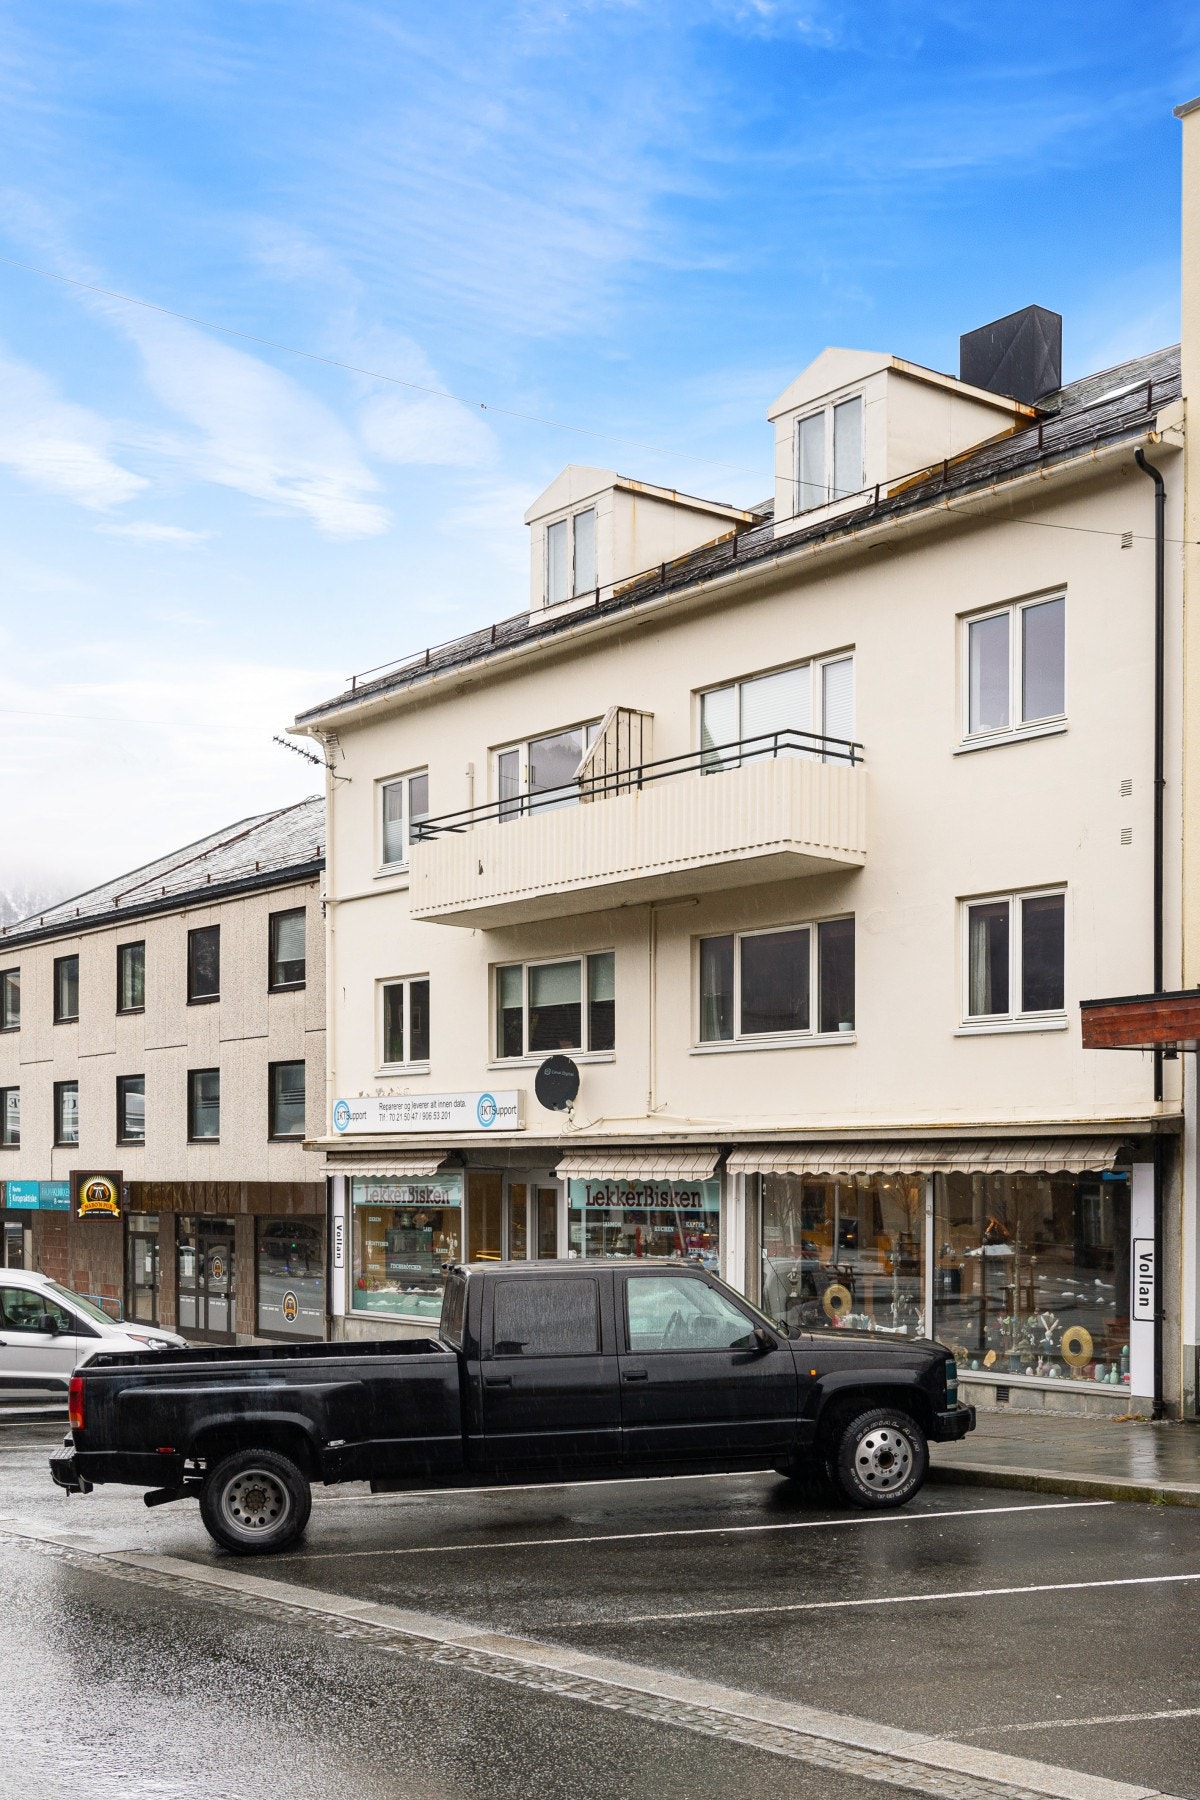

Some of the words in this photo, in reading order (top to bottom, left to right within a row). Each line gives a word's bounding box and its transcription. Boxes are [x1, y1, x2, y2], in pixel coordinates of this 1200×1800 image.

[378, 1102, 403, 1112] Reparerer
[404, 1103, 410, 1111] og
[412, 1101, 429, 1109] leverer
[438, 1100, 452, 1108] innen
[396, 1113, 402, 1122] 21
[411, 1112, 418, 1120] 47
[433, 1112, 440, 1120] 53
[441, 1111, 451, 1120] 201
[364, 1184, 450, 1204] LekkerBisken
[586, 1184, 702, 1208] LekkerBisken
[1139, 1252, 1153, 1306] Vollan
